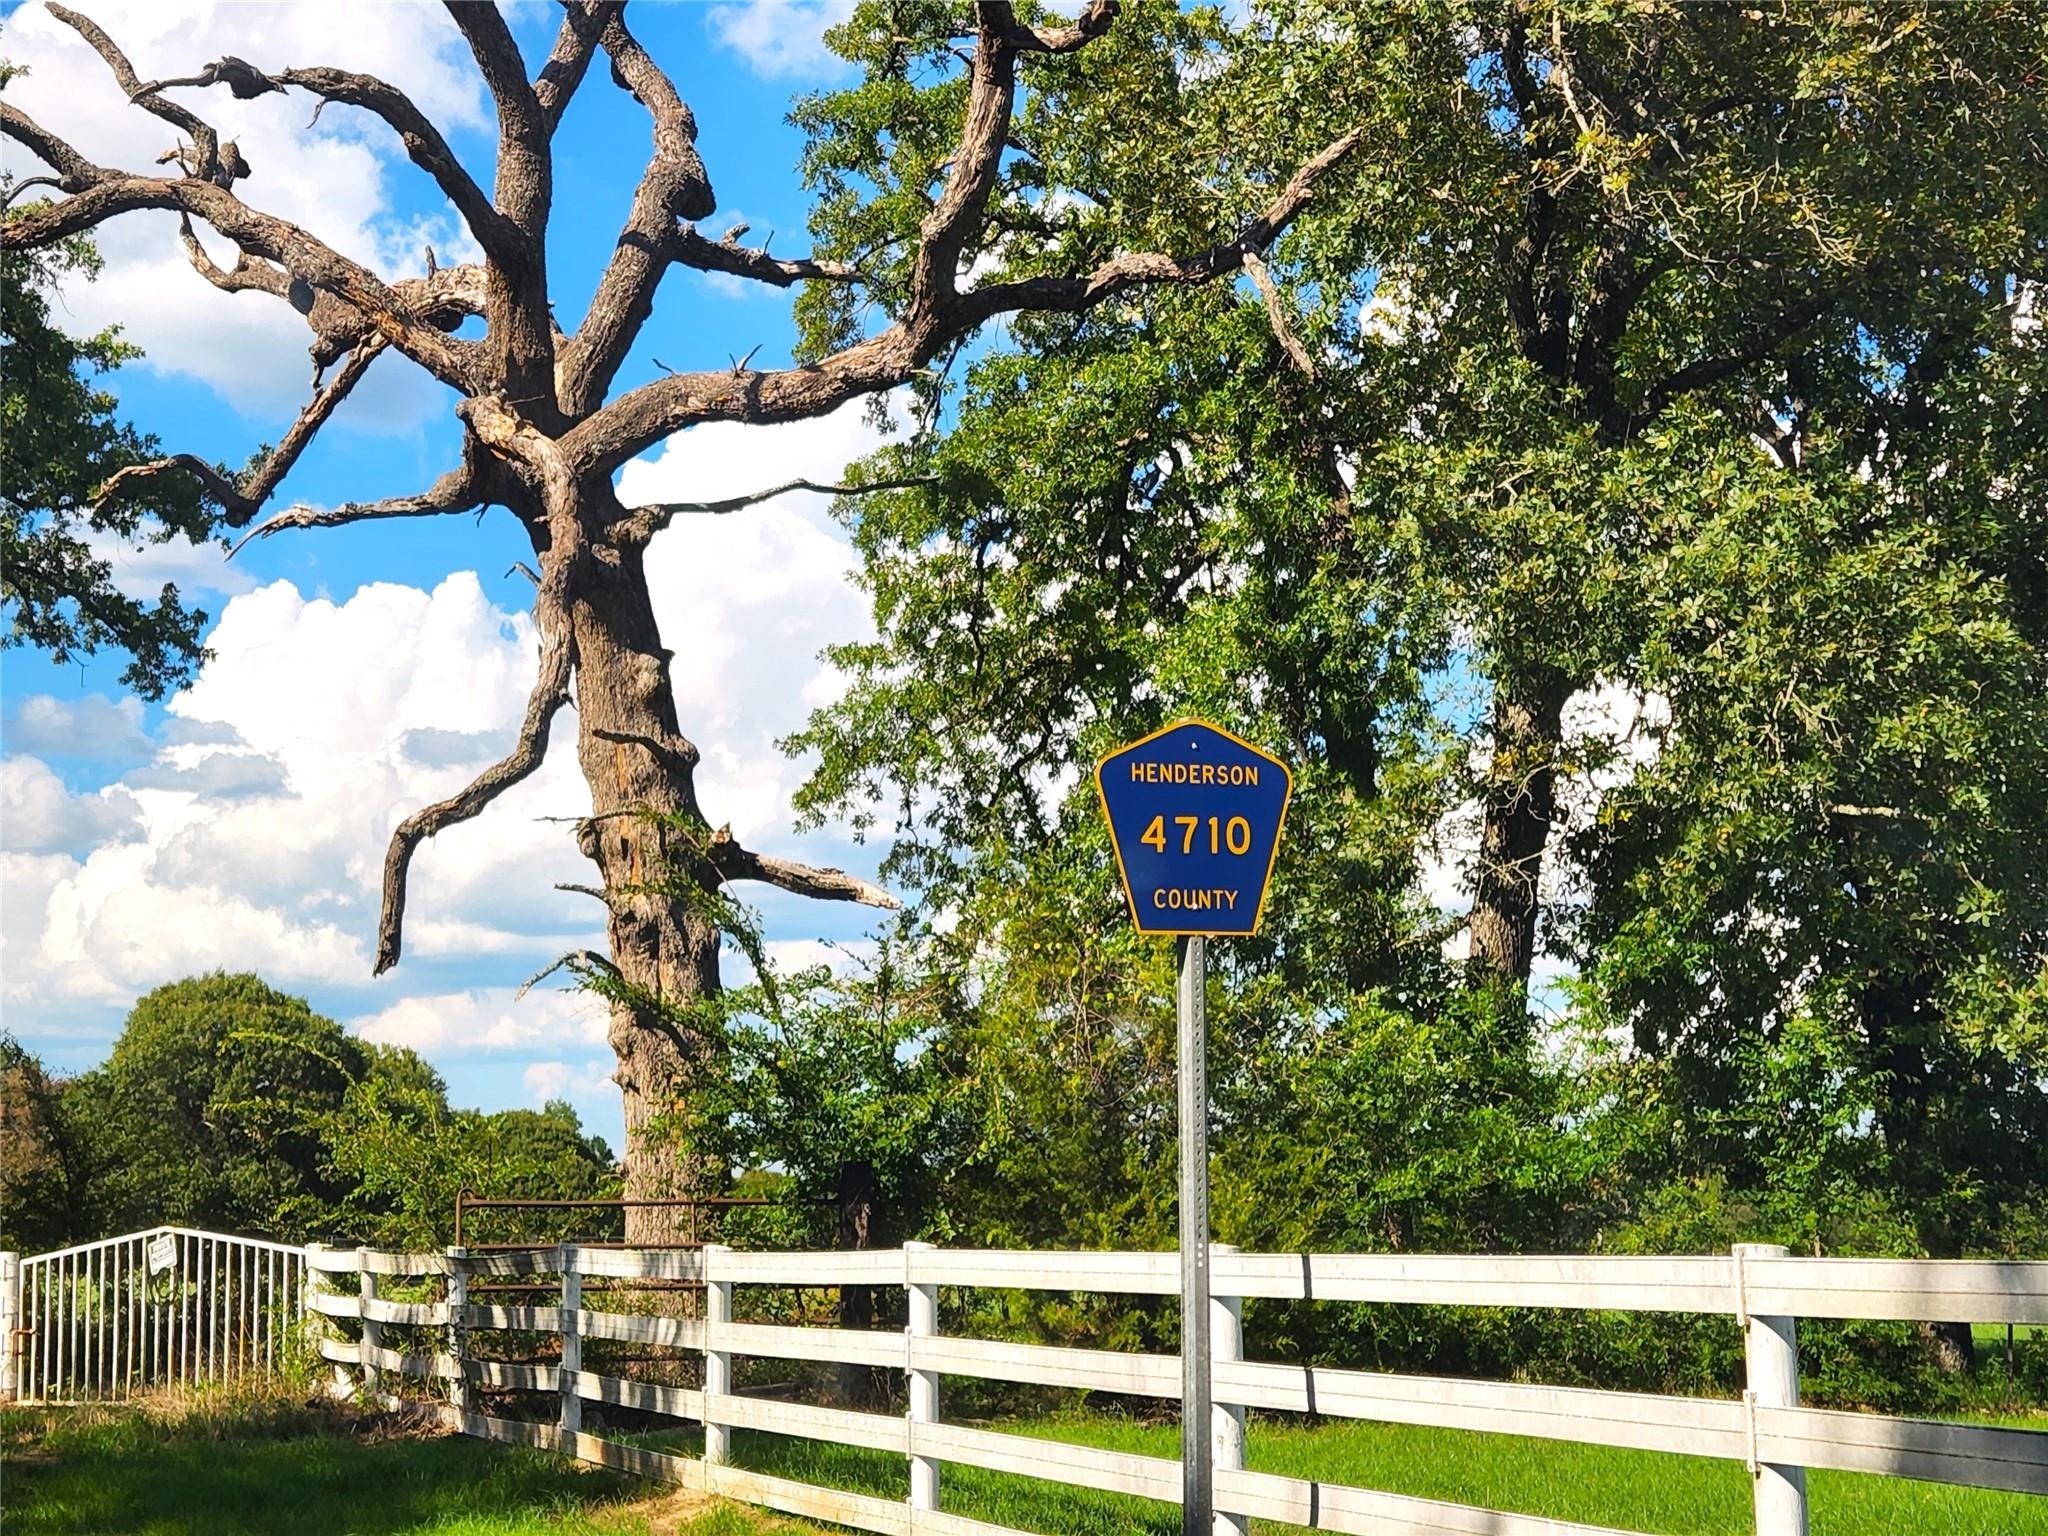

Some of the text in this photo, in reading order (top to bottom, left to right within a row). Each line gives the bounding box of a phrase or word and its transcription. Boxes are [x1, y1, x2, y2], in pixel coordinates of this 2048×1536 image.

[1131, 762, 1259, 786] HENDERSON
[1140, 815, 1251, 855] 4710
[1153, 888, 1238, 910] COUNTY
